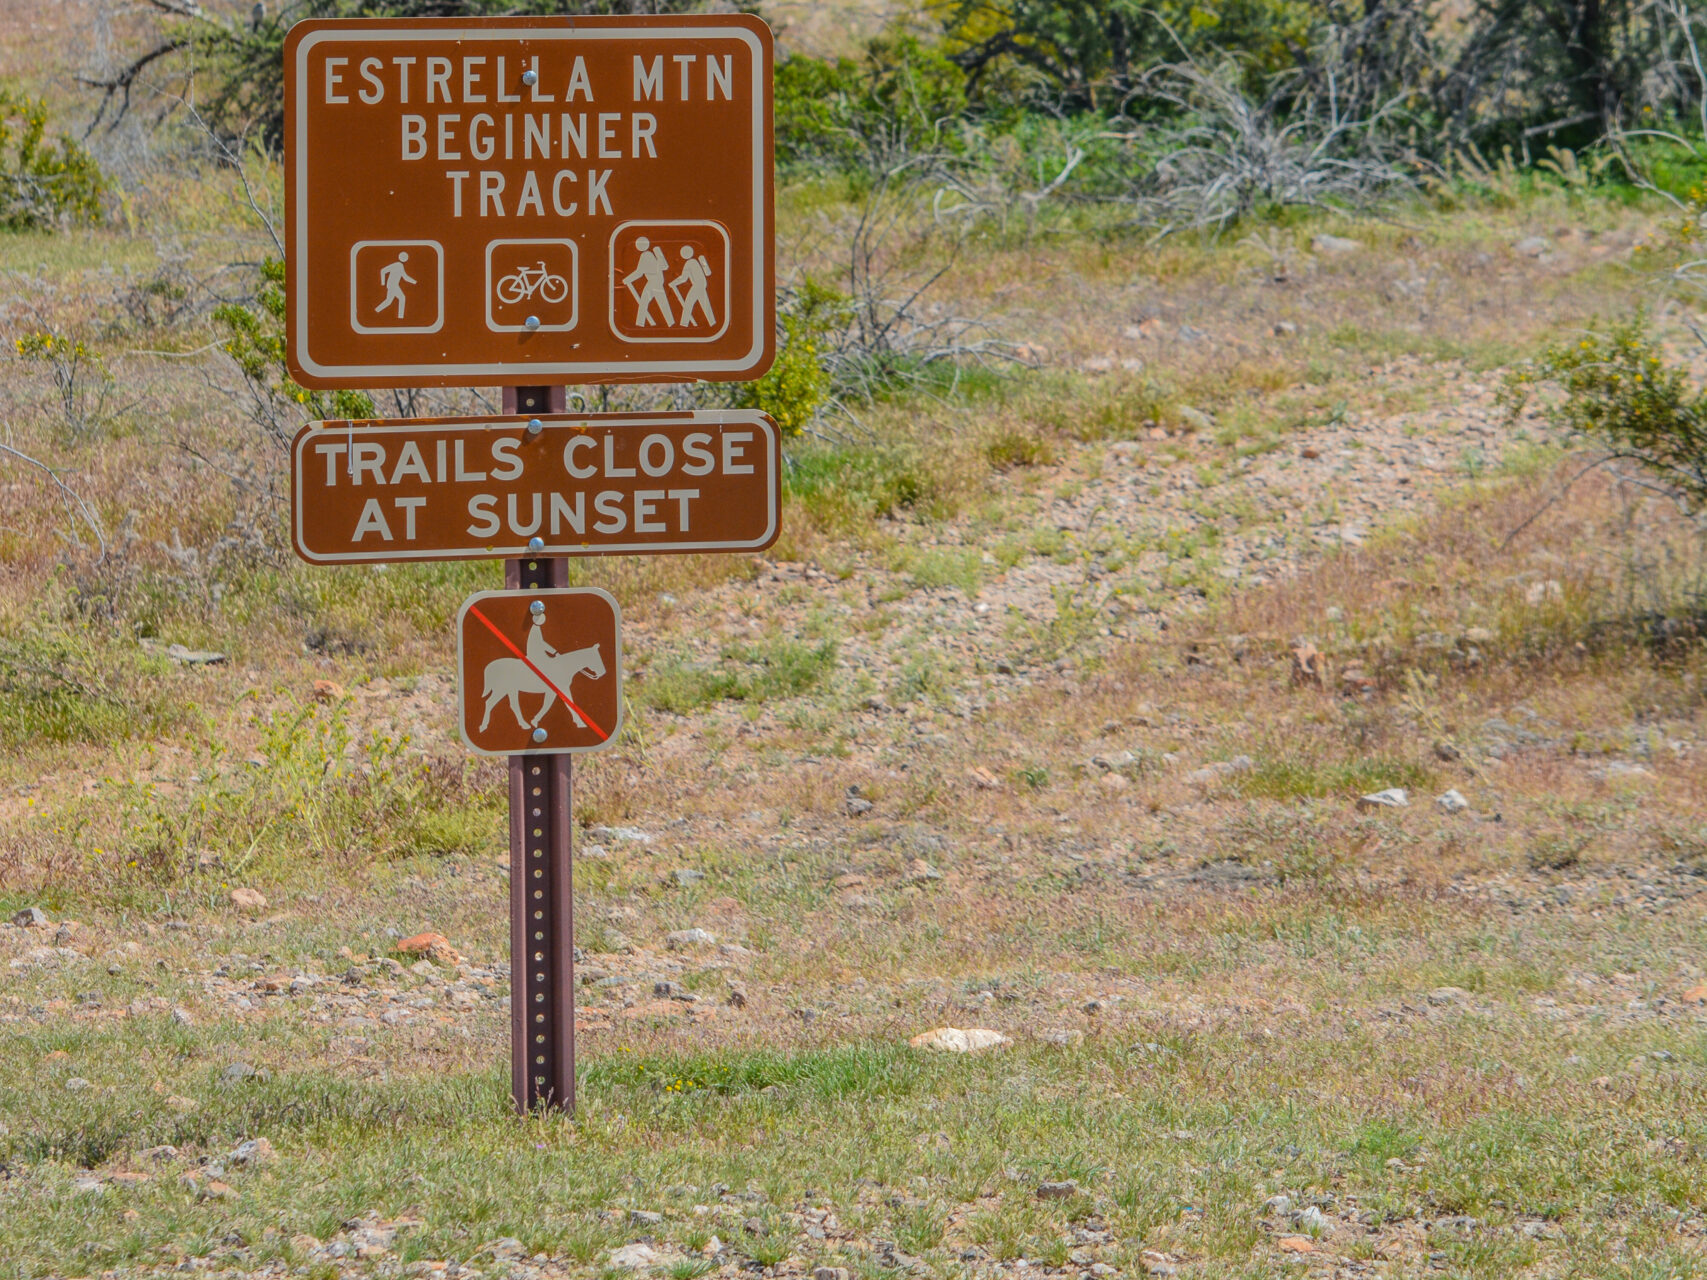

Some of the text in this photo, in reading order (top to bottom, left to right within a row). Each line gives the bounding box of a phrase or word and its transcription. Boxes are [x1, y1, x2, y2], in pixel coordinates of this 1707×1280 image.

[325, 54, 732, 105] ESTRELLA MTN
[401, 112, 658, 161] BEGINNER
[446, 169, 614, 218] TRACK
[315, 432, 755, 486] TRAILS CLOSE
[351, 489, 700, 542] AT SUNSET
